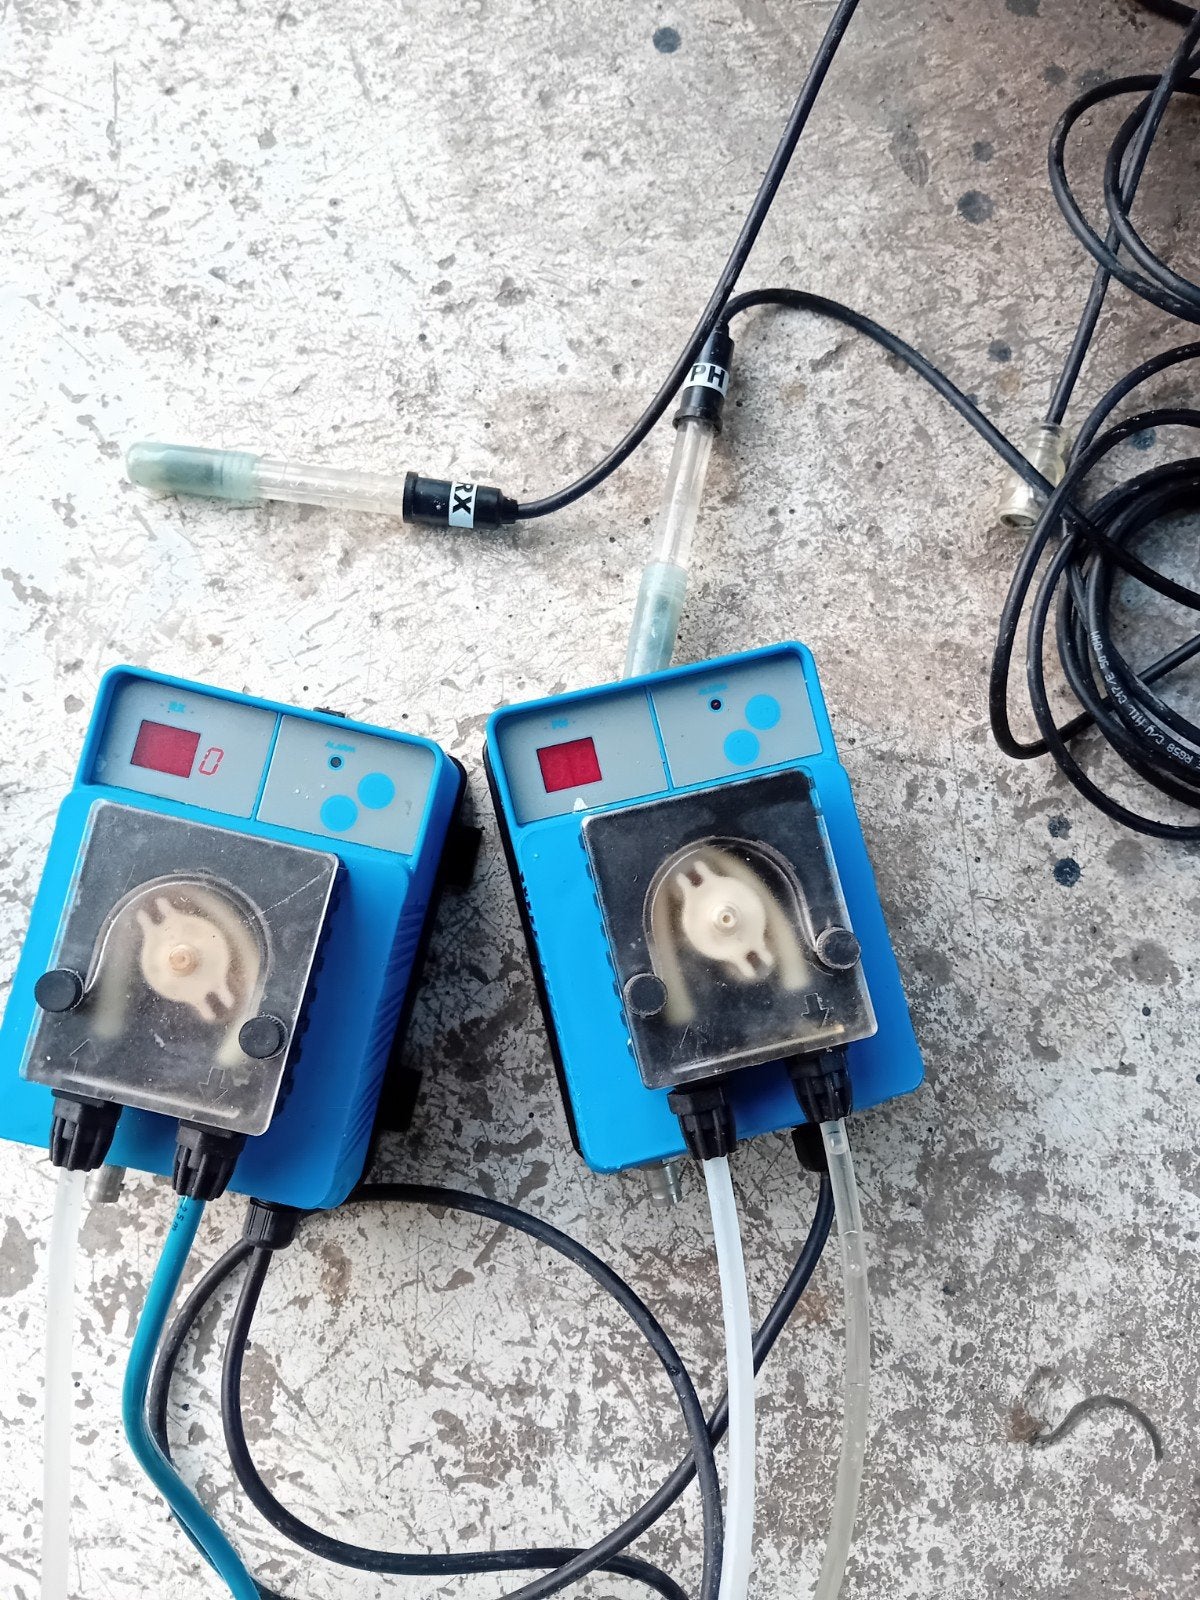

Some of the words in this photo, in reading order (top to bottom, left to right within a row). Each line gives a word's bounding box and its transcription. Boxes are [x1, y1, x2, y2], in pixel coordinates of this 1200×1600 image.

[690, 364, 726, 389] PH
[452, 482, 475, 515] RX
[1090, 630, 1103, 651] OHM
[1098, 655, 1110, 669] 50
[1166, 743, 1193, 764] RG58
